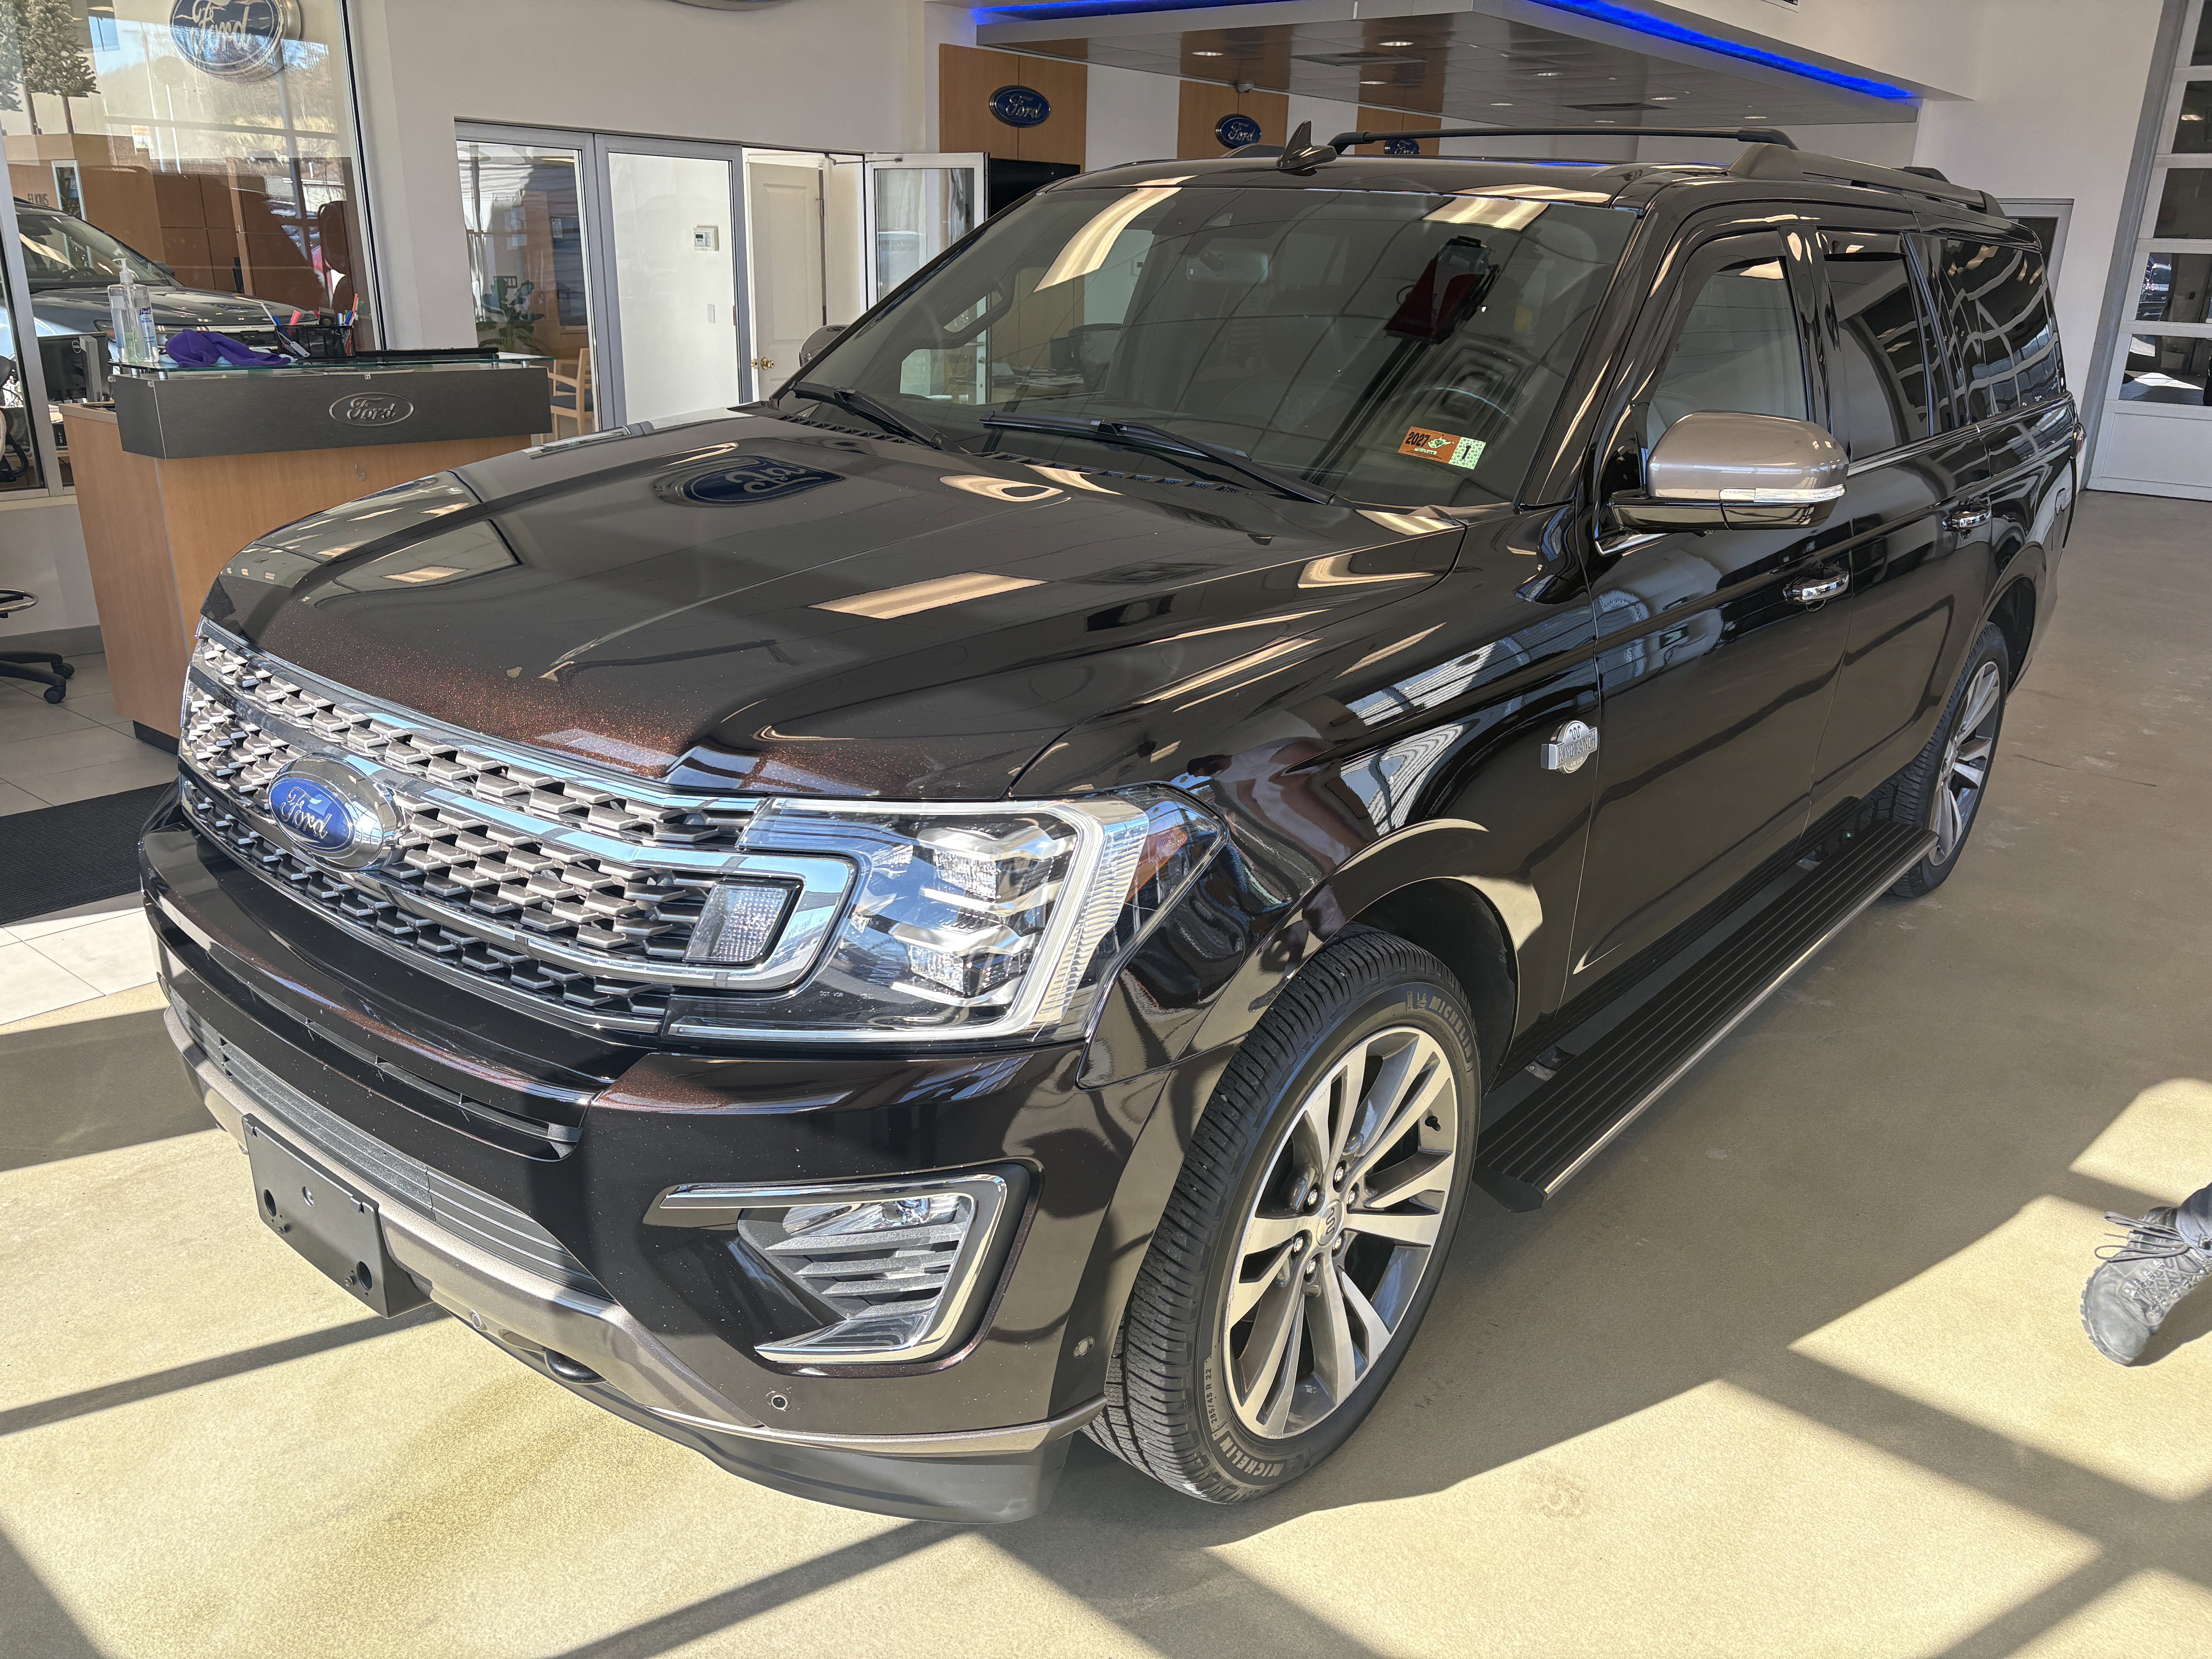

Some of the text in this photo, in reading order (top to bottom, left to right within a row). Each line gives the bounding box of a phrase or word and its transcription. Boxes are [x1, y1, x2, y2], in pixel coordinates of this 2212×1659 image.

[189, 0, 251, 54] Ford
[1006, 94, 1042, 118] Ford
[1228, 122, 1255, 142] Ford
[347, 397, 396, 419] Ford
[1405, 431, 1431, 447] 2027
[1462, 445, 1471, 460] 1
[1559, 743, 1575, 762] KING
[1576, 731, 1595, 755] RANCH
[280, 787, 333, 840] Ford
[1429, 996, 1472, 1058] MICHELIN
[1206, 1368, 1212, 1380] 22
[1206, 1393, 1217, 1424] 285/45
[1219, 1436, 1285, 1477] MICHELIN
